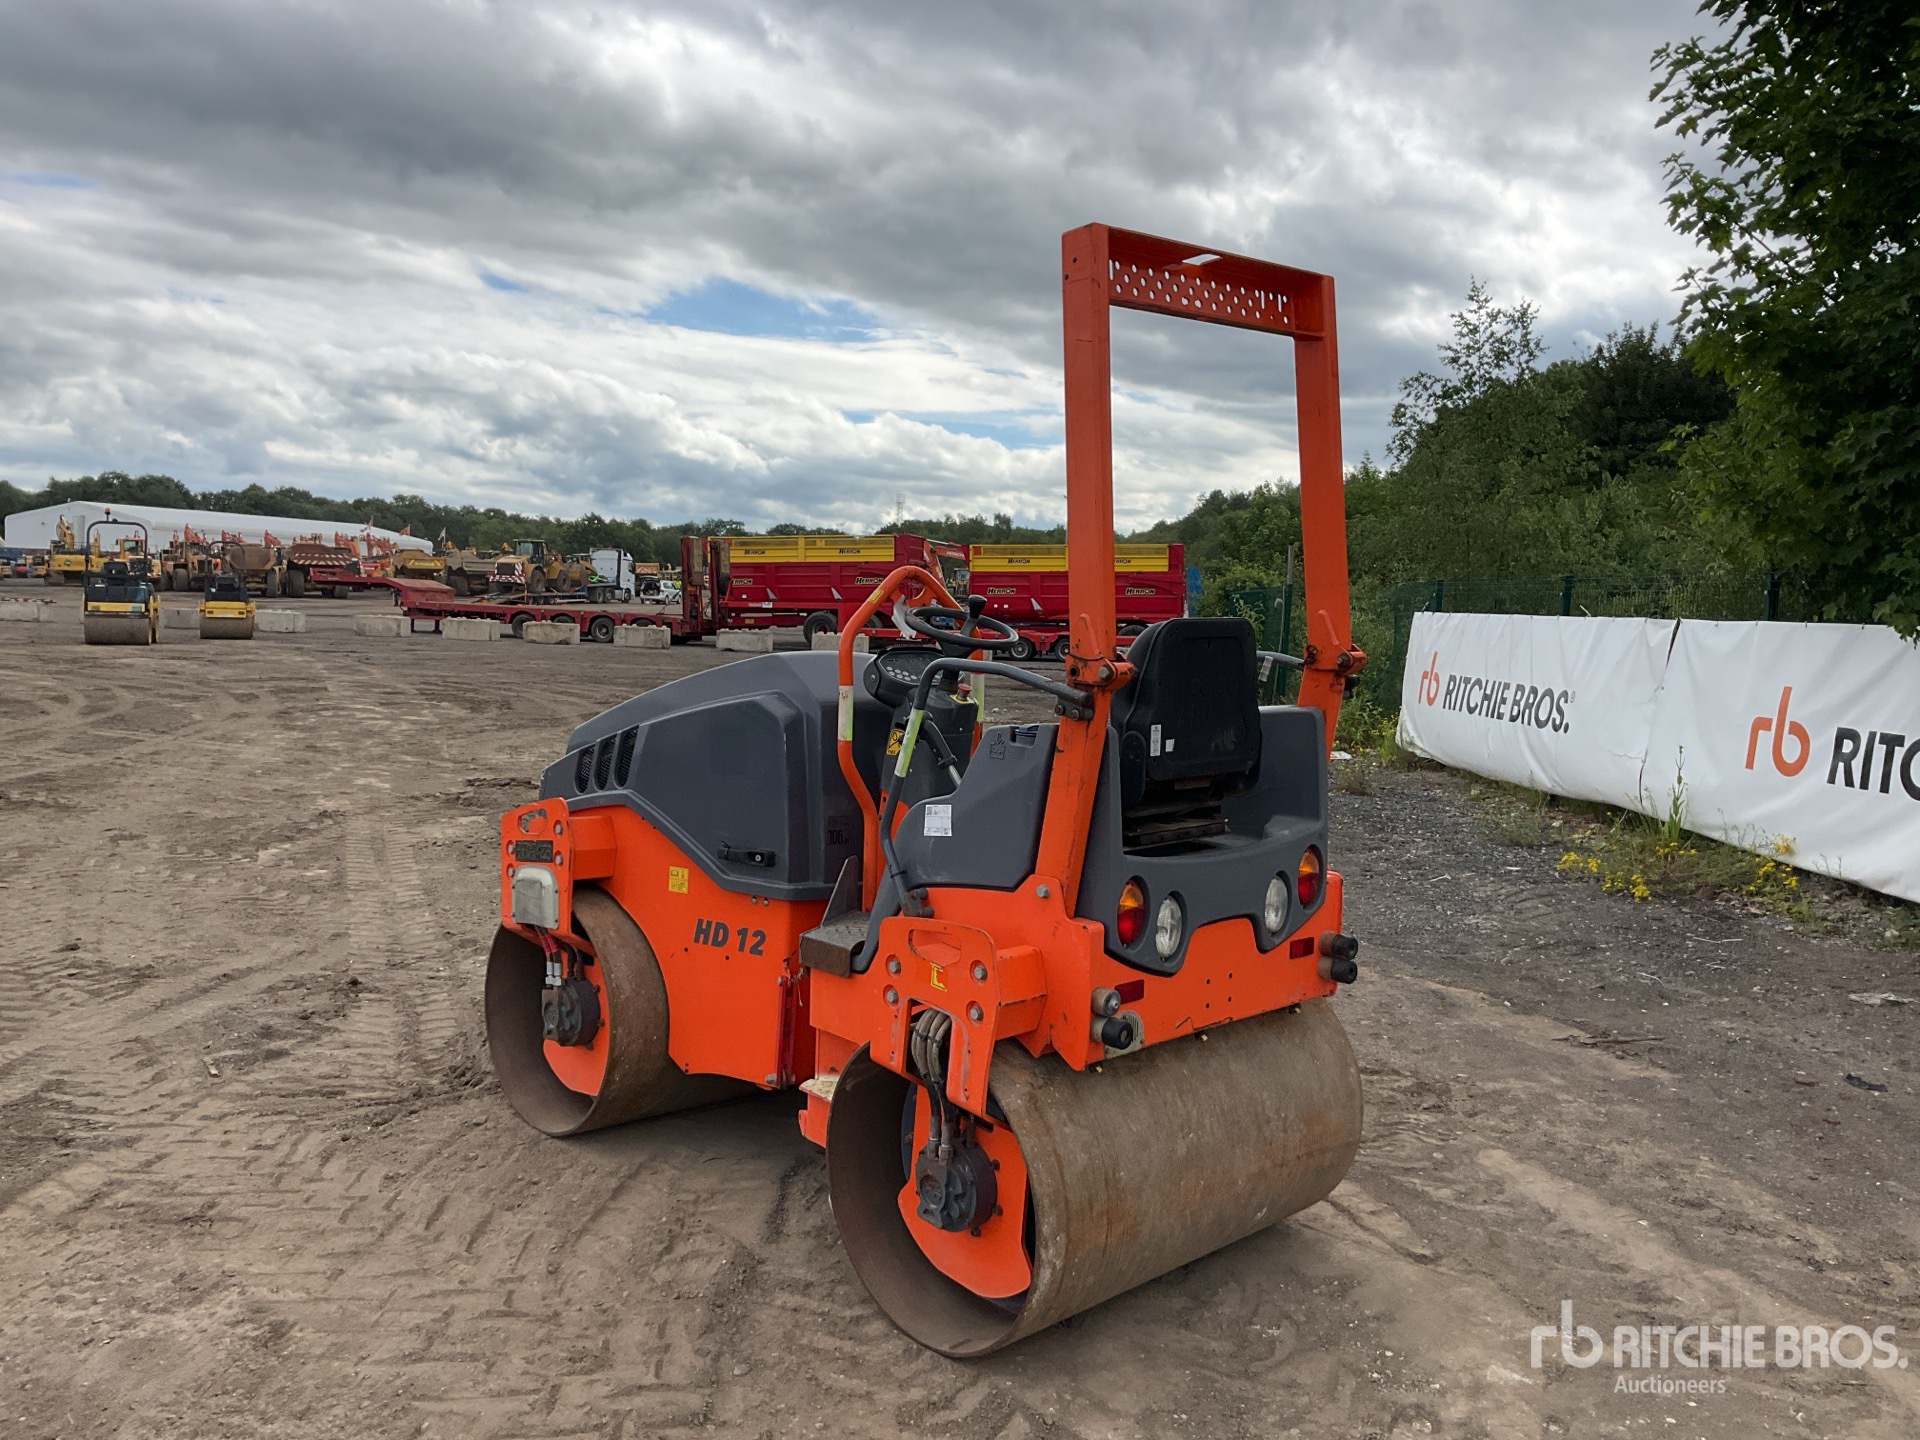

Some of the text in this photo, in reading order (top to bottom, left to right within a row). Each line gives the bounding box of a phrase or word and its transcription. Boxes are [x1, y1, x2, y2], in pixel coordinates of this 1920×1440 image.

[987, 587, 1016, 595] HERRON
[1443, 674, 1511, 720] RITCHIE
[694, 918, 766, 956] HD 12
